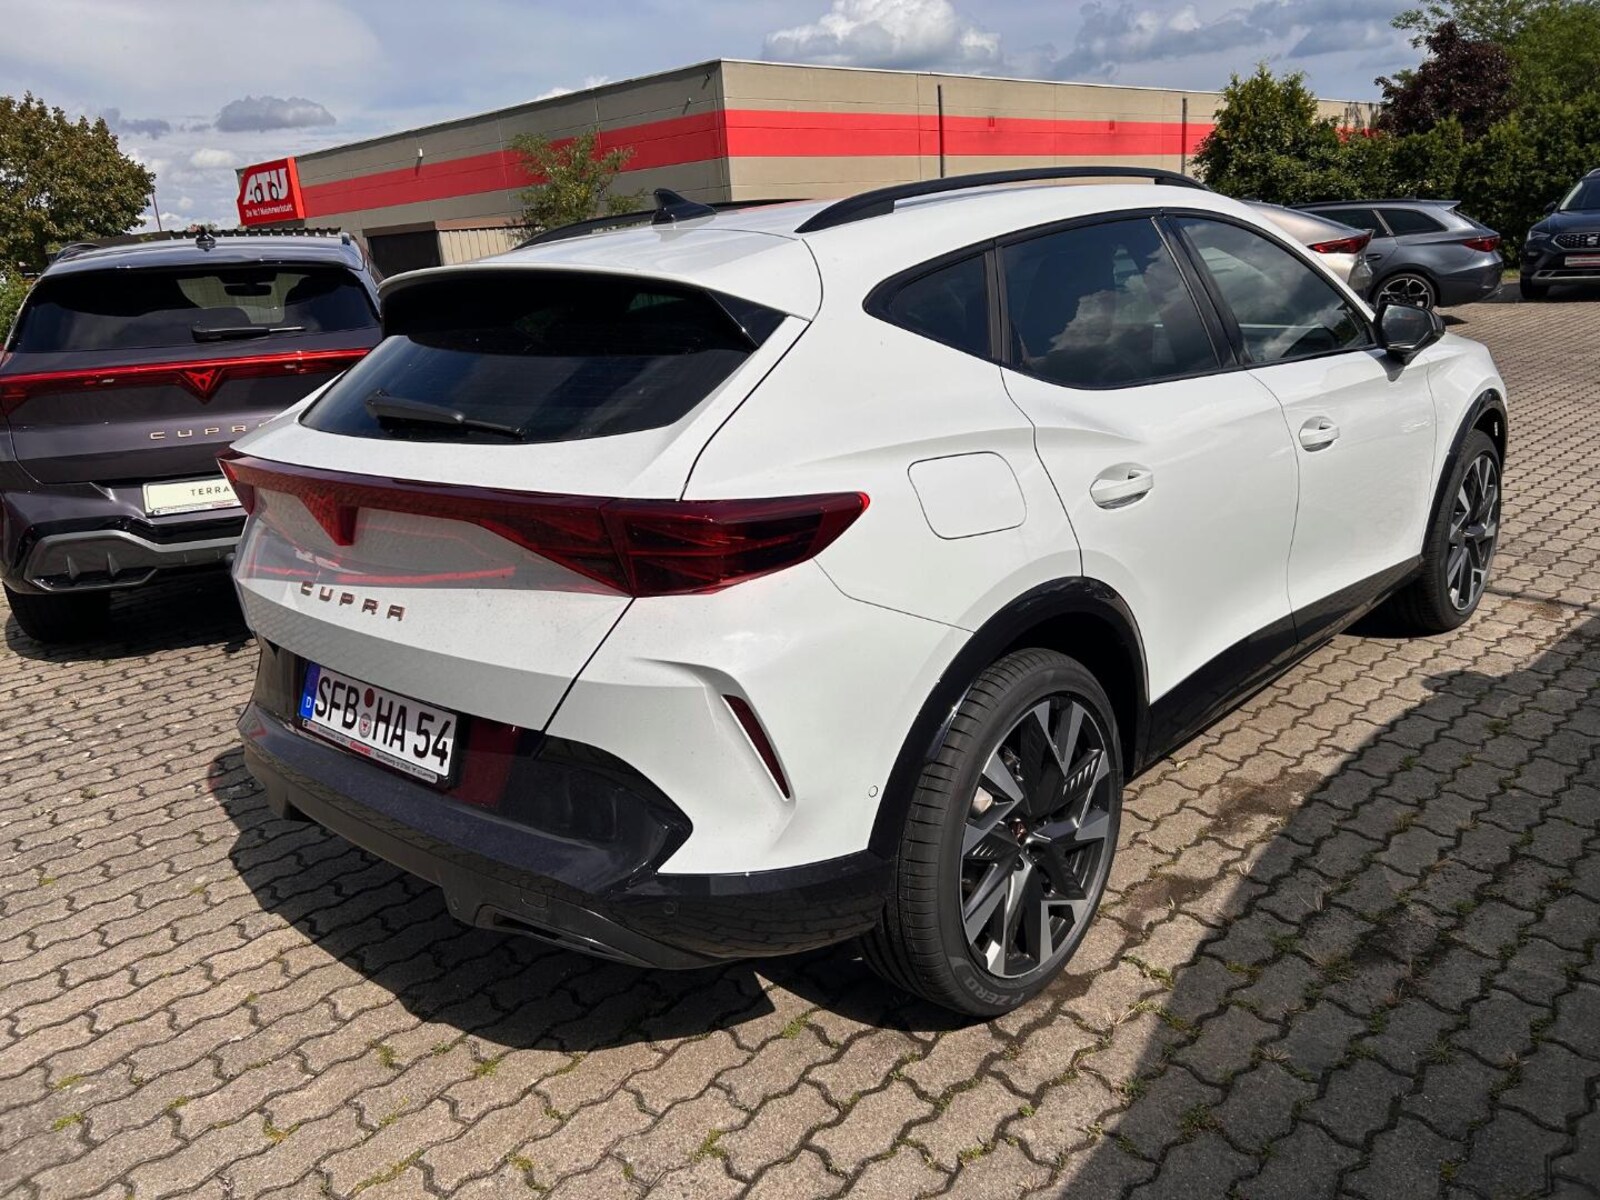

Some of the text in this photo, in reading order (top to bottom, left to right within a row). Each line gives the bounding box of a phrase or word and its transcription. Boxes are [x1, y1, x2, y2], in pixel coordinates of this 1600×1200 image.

[243, 168, 288, 205] ATU
[150, 424, 265, 440] CUPR
[190, 486, 230, 497] TERRA
[301, 581, 405, 621] CUPRA
[305, 696, 312, 709] D
[314, 676, 360, 730] SFB
[372, 697, 407, 752] HA
[413, 711, 451, 767] 54
